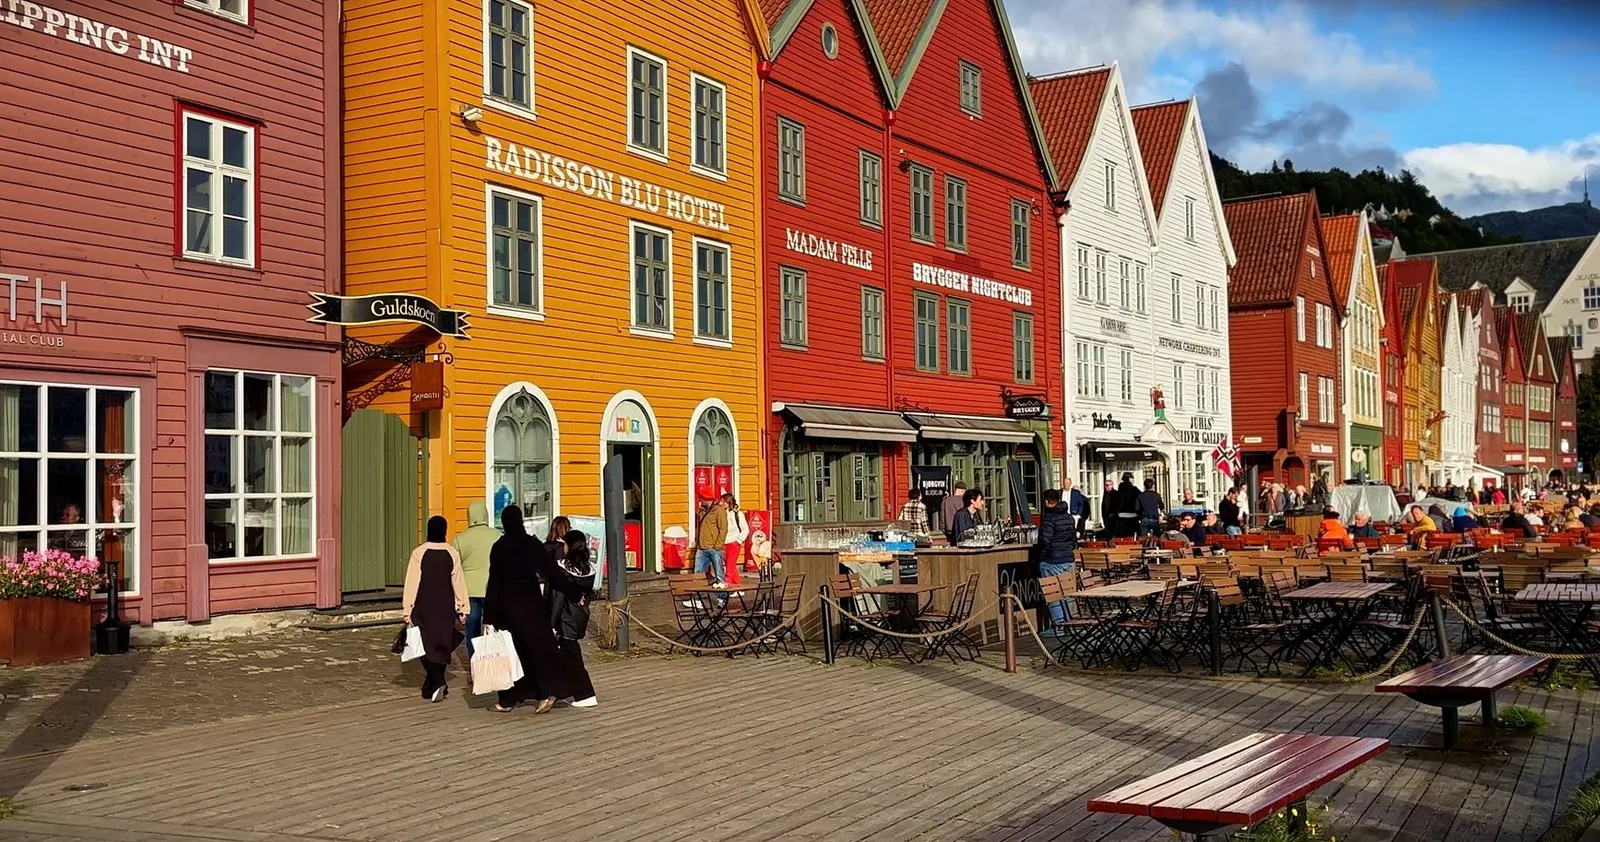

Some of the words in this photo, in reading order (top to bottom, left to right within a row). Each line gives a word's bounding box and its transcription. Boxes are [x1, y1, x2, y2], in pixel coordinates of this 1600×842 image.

[0, 0, 130, 54] IPPING
[137, 34, 193, 73] INT
[485, 136, 614, 201] RADISSON
[620, 175, 661, 214] BLU
[665, 188, 730, 231] HOTEL
[786, 228, 838, 262] MADAM
[841, 242, 873, 271] FELLE
[912, 262, 969, 292] BRYGGEN
[971, 276, 1032, 307] NIGHTCLUB
[370, 298, 436, 324] Guldskoen
[30, 334, 64, 347] CLUB
[616, 417, 640, 434] MIX
[1012, 406, 1041, 414] BRYGGEN
